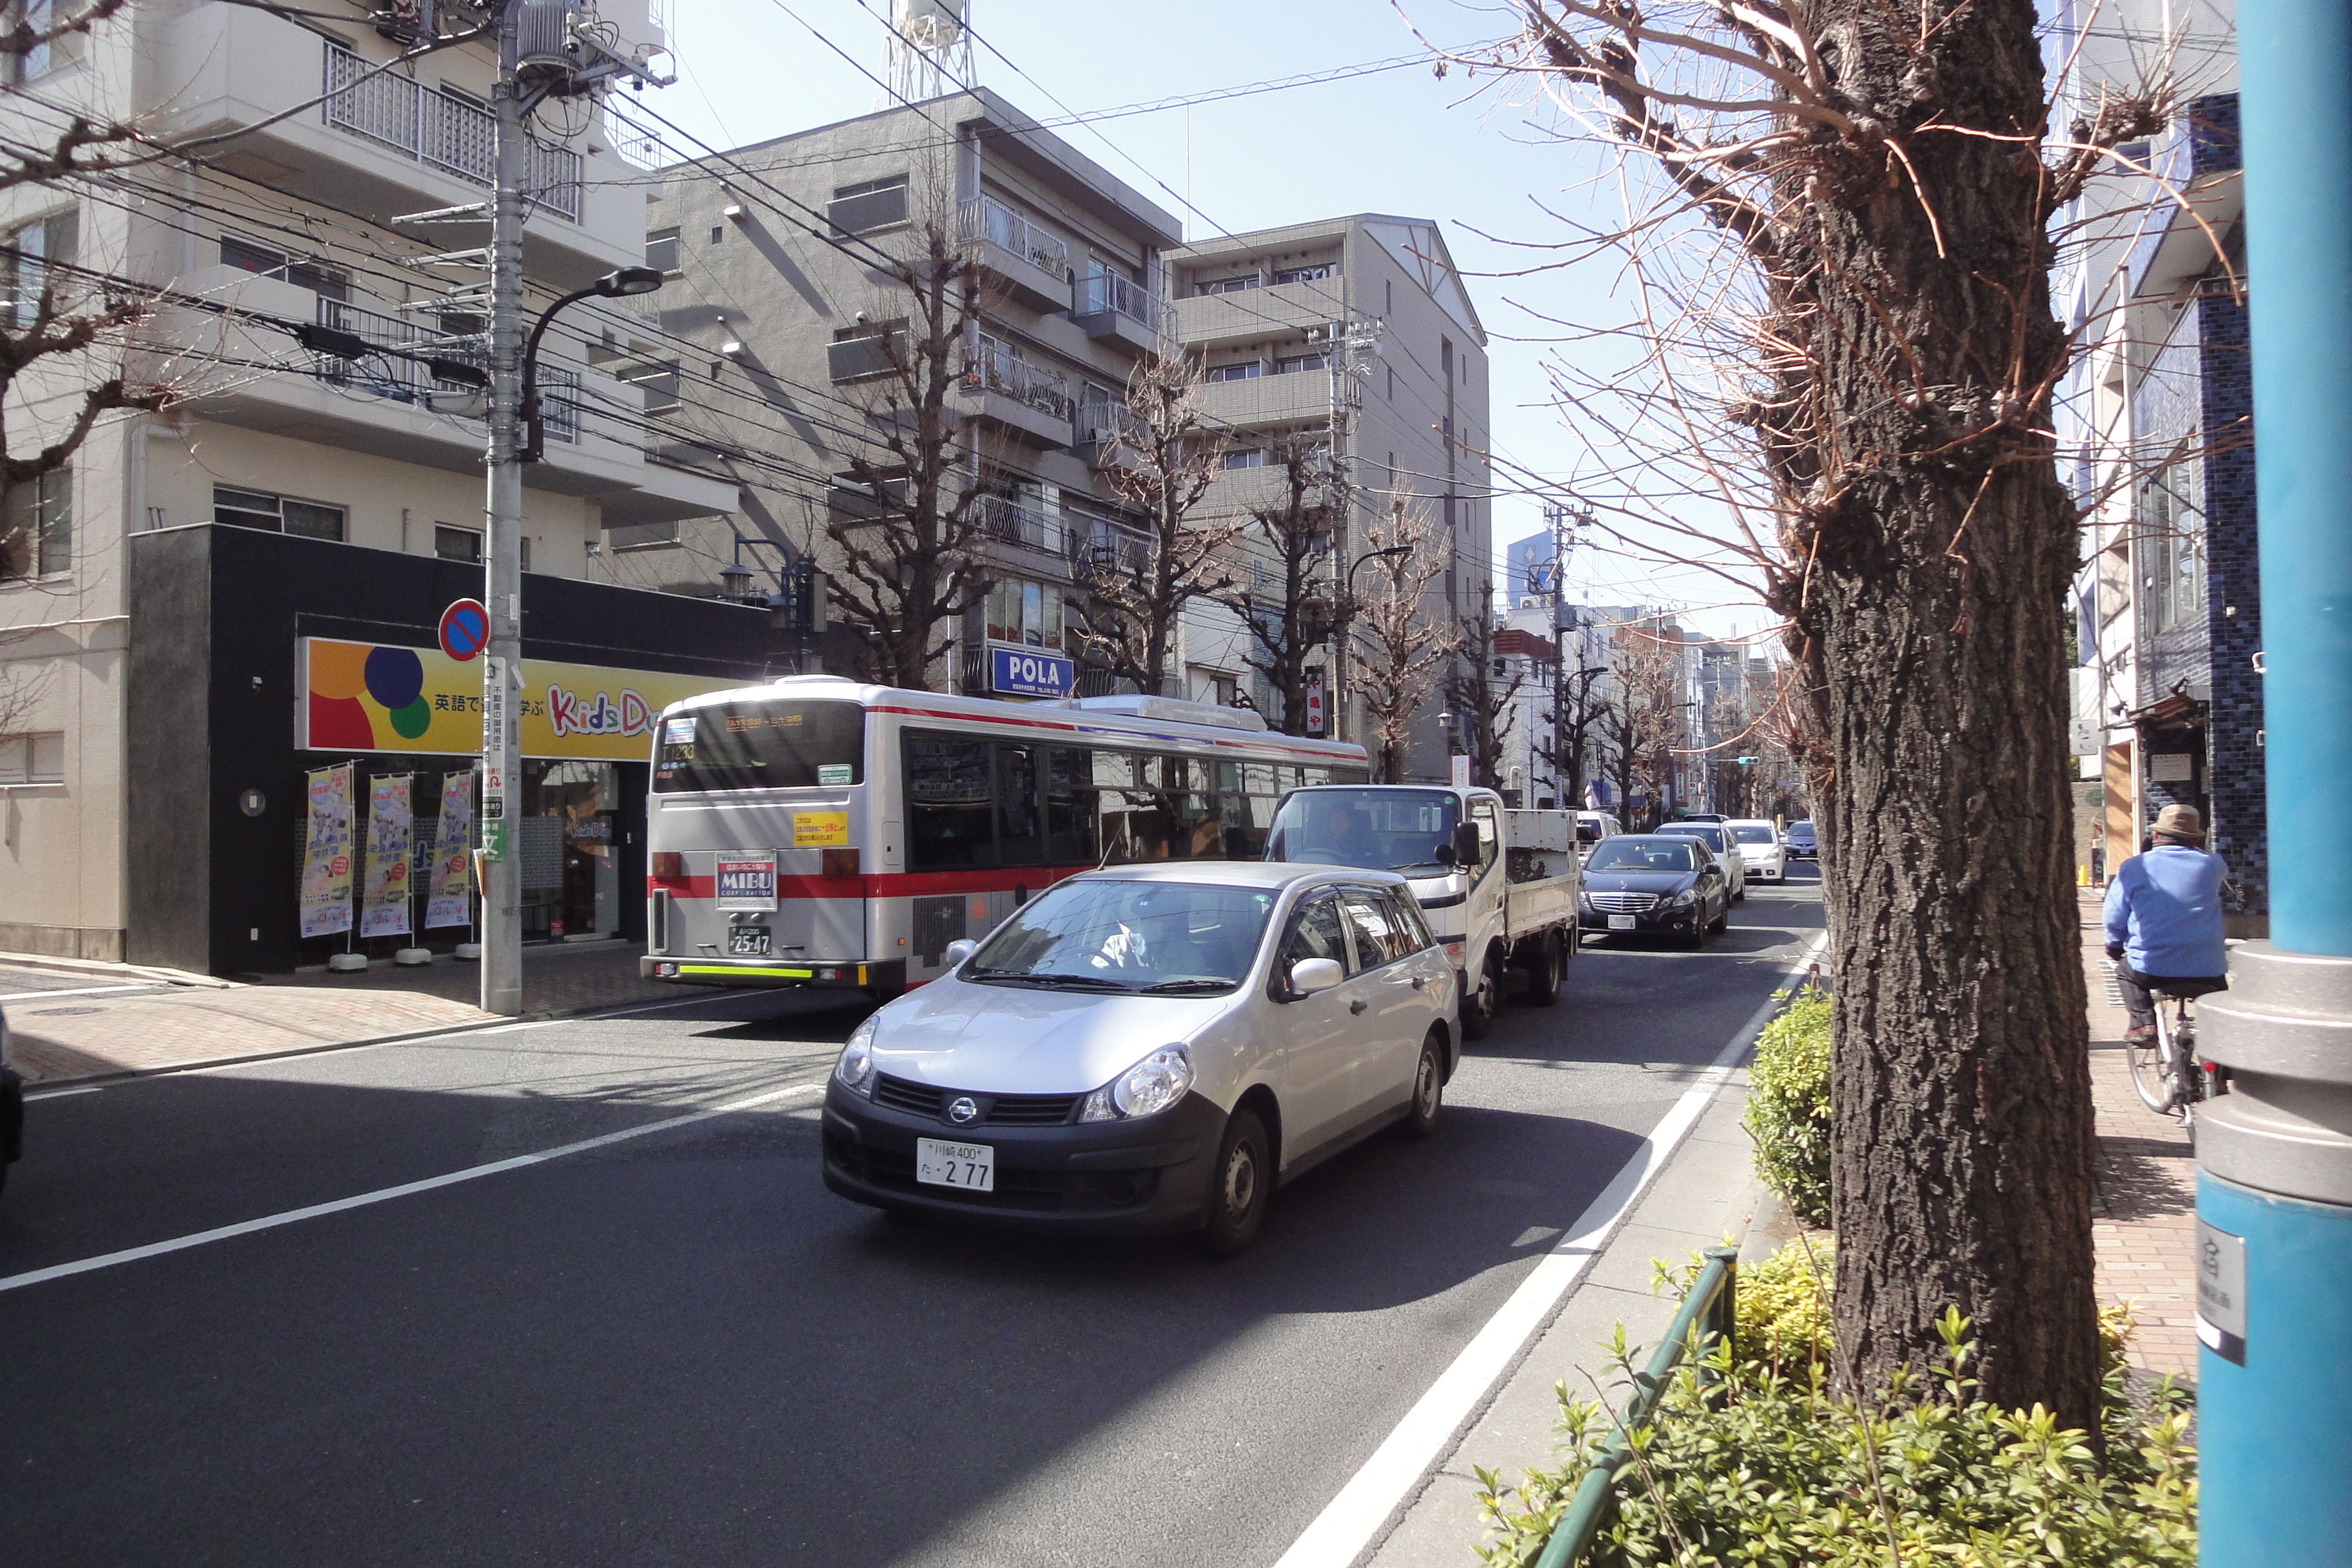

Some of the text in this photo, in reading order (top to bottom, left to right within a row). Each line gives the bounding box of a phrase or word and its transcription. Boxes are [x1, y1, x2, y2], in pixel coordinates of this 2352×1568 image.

[1010, 656, 1059, 685] POLA
[548, 685, 658, 736] KidsDu
[721, 873, 771, 888] MIBU
[735, 936, 769, 953] 25-47
